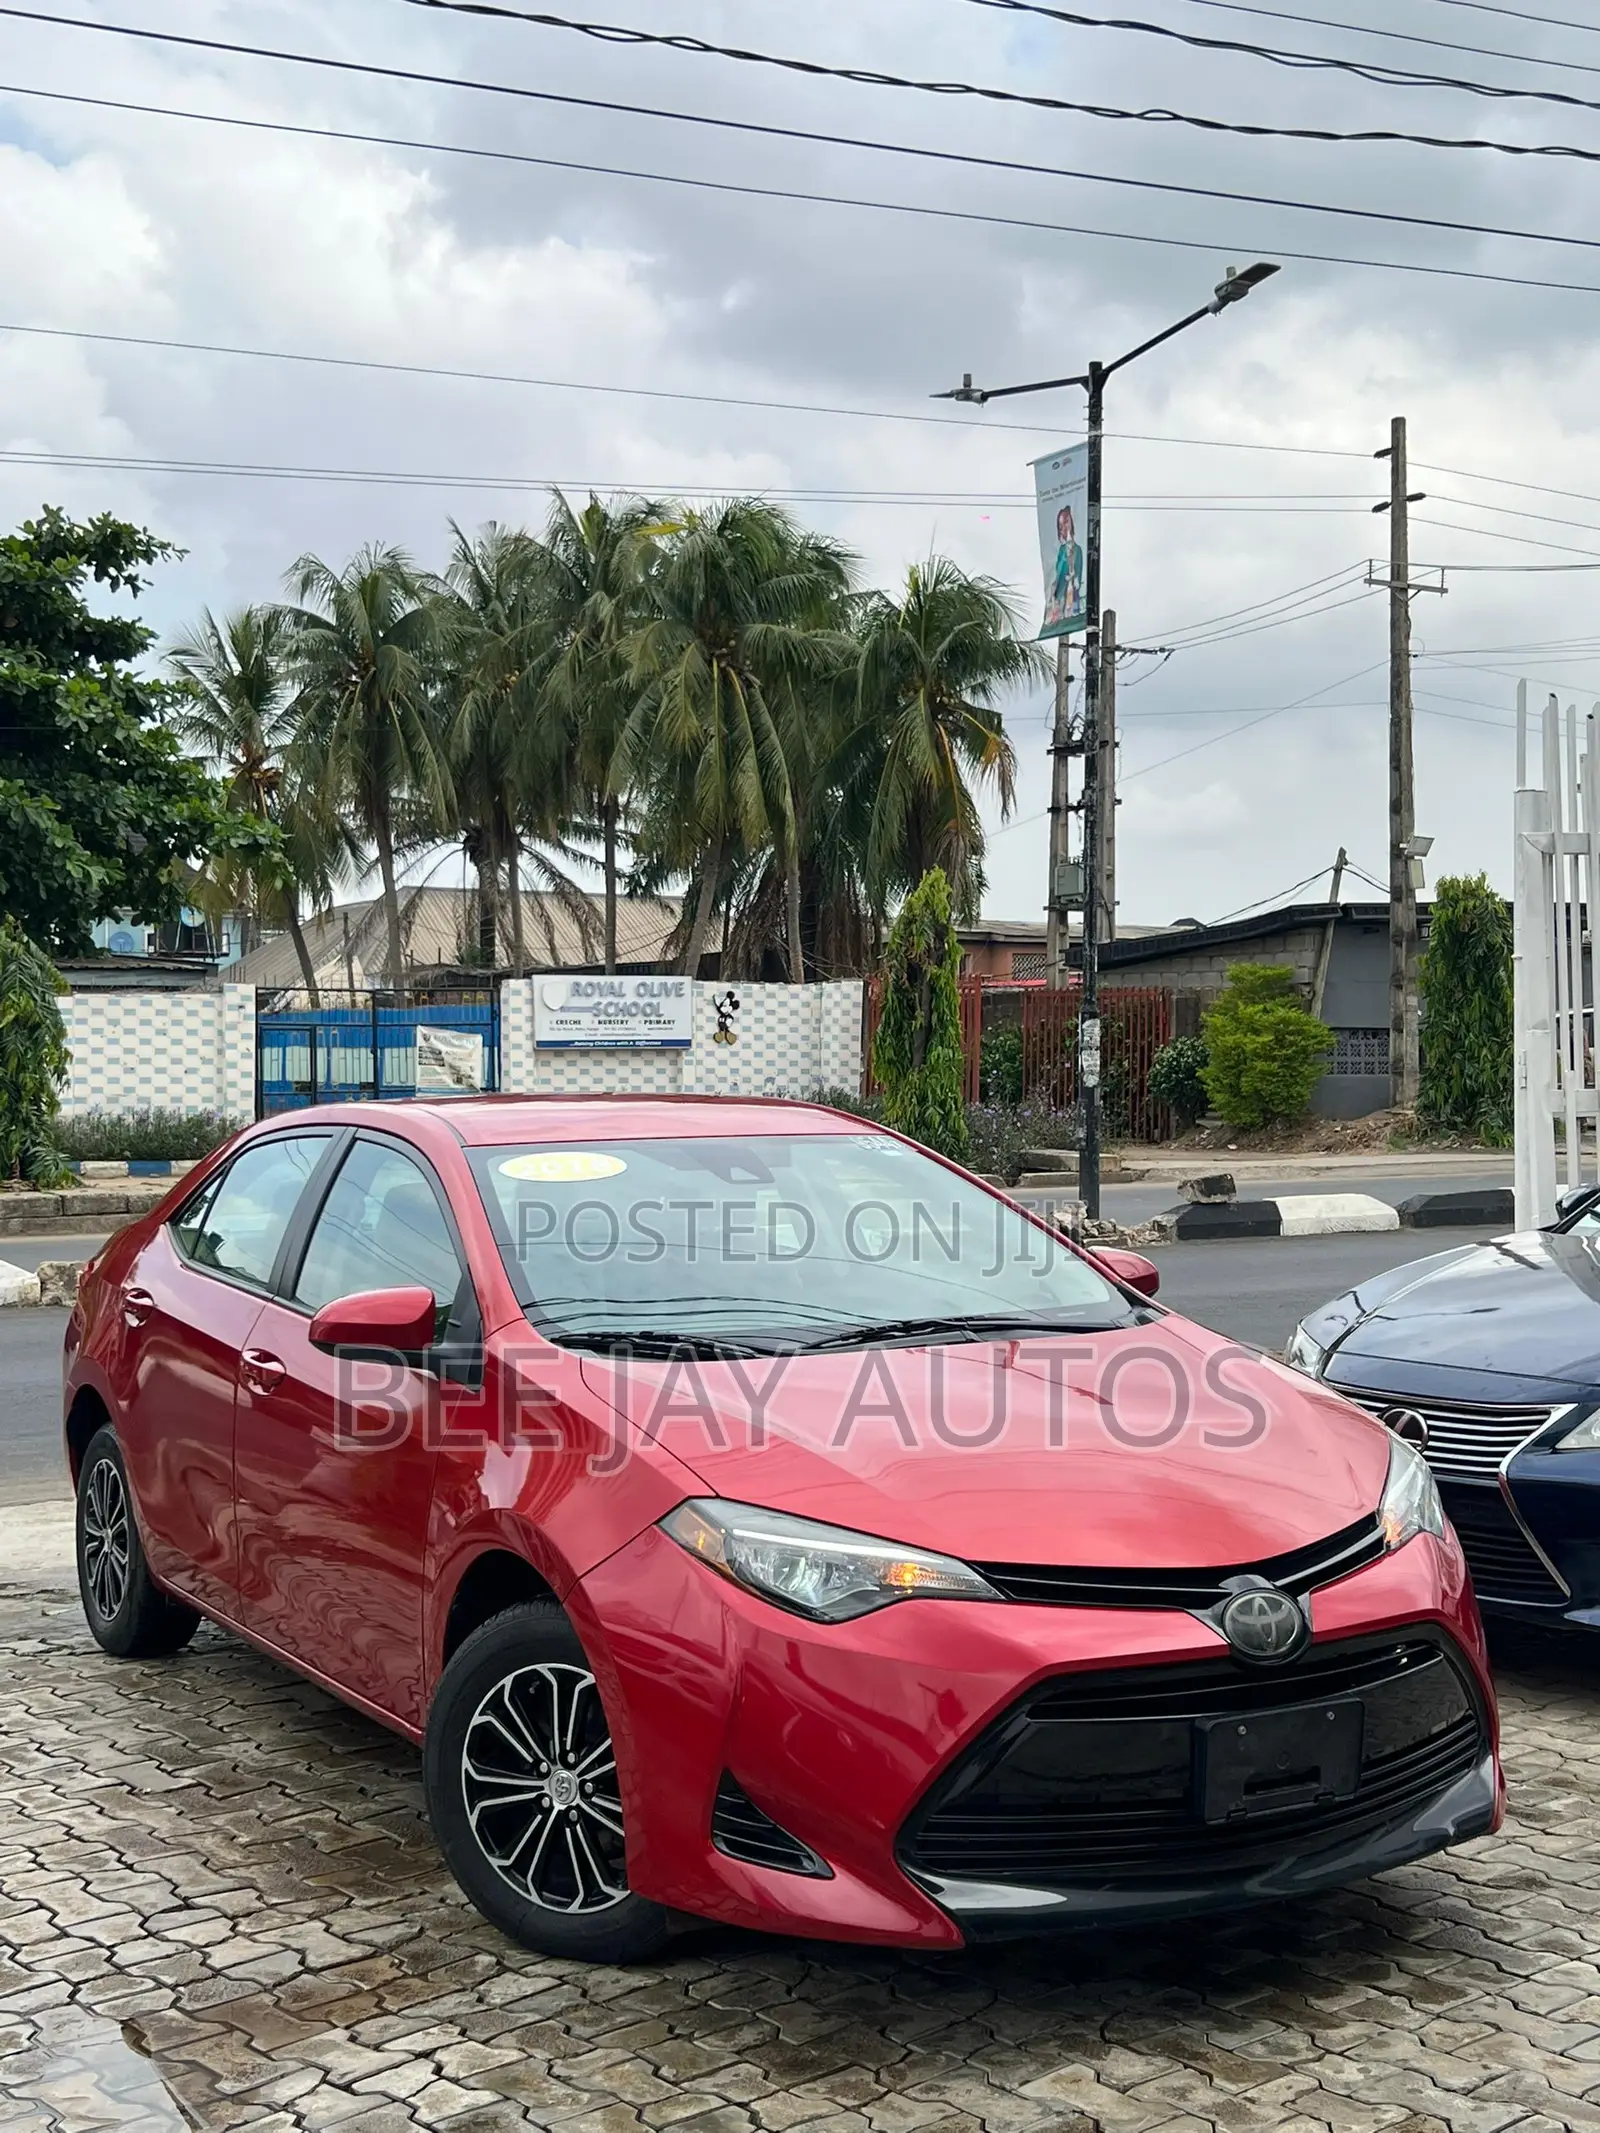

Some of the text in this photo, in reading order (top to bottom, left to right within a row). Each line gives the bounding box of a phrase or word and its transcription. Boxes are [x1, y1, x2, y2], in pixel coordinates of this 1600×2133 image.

[570, 981, 686, 998] ROYAL OLIVE
[591, 1001, 665, 1018] SCHOOL
